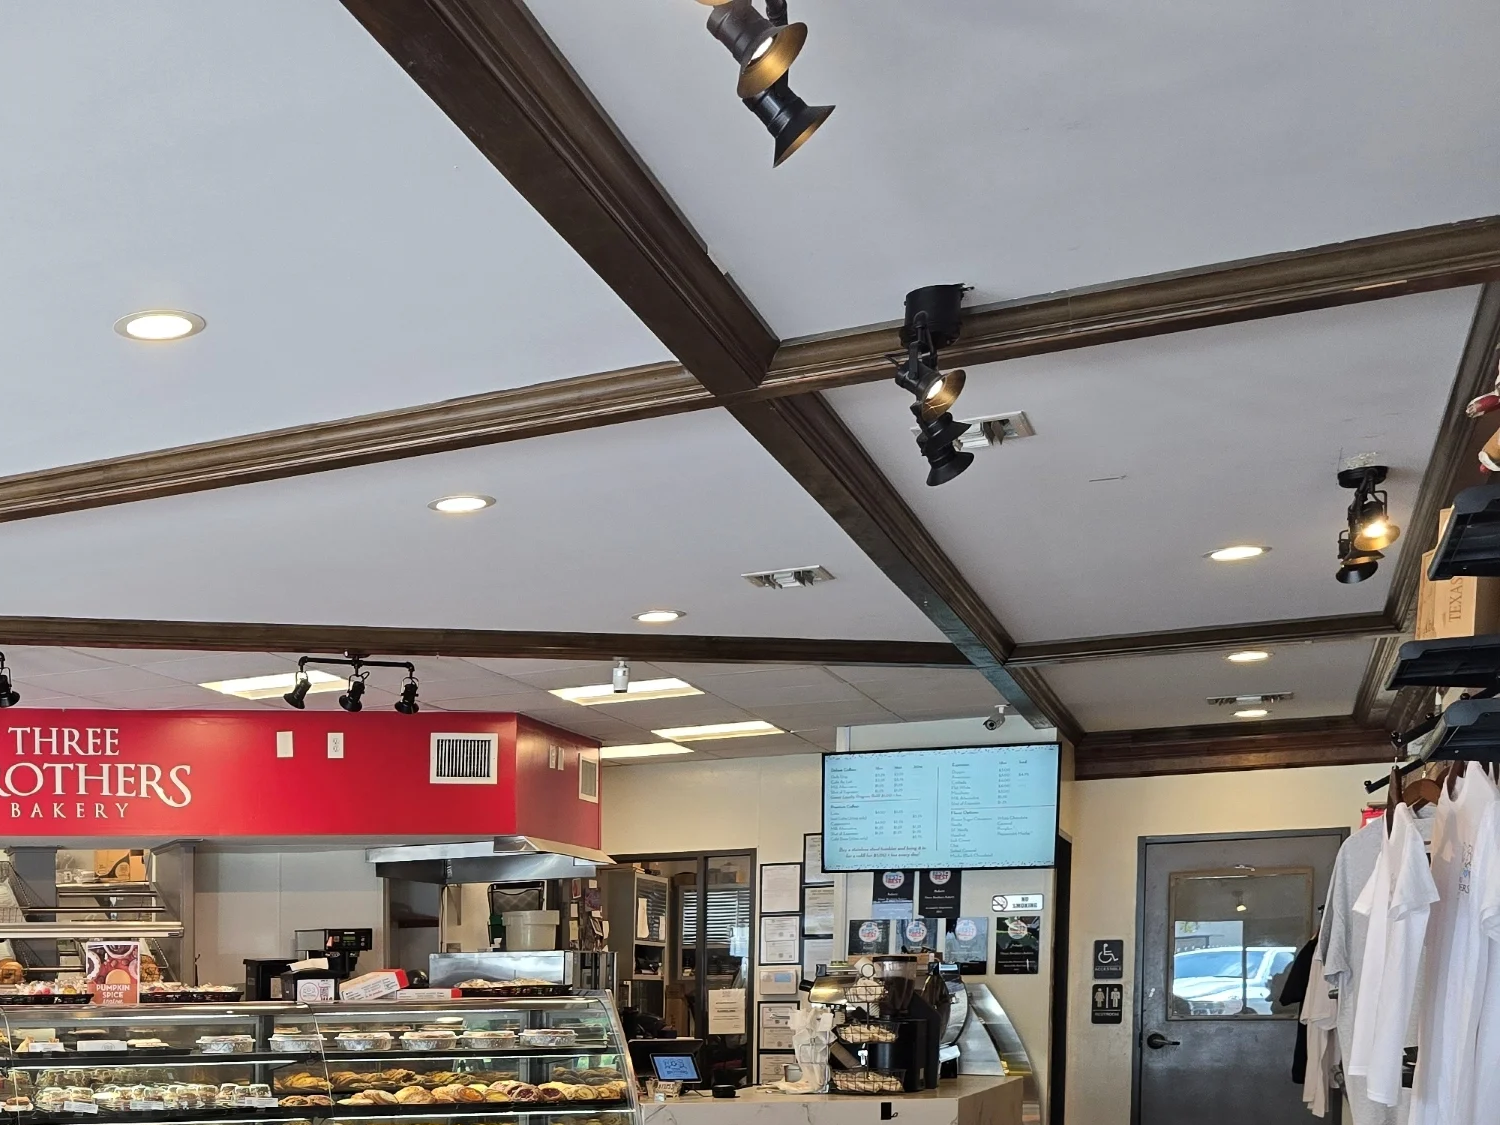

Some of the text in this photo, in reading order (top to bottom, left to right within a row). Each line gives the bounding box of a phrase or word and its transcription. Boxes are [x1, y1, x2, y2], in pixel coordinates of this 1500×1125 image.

[1448, 577, 1463, 622] TEXAS
[8, 726, 120, 756] THREE
[11, 803, 129, 818] BAKERY
